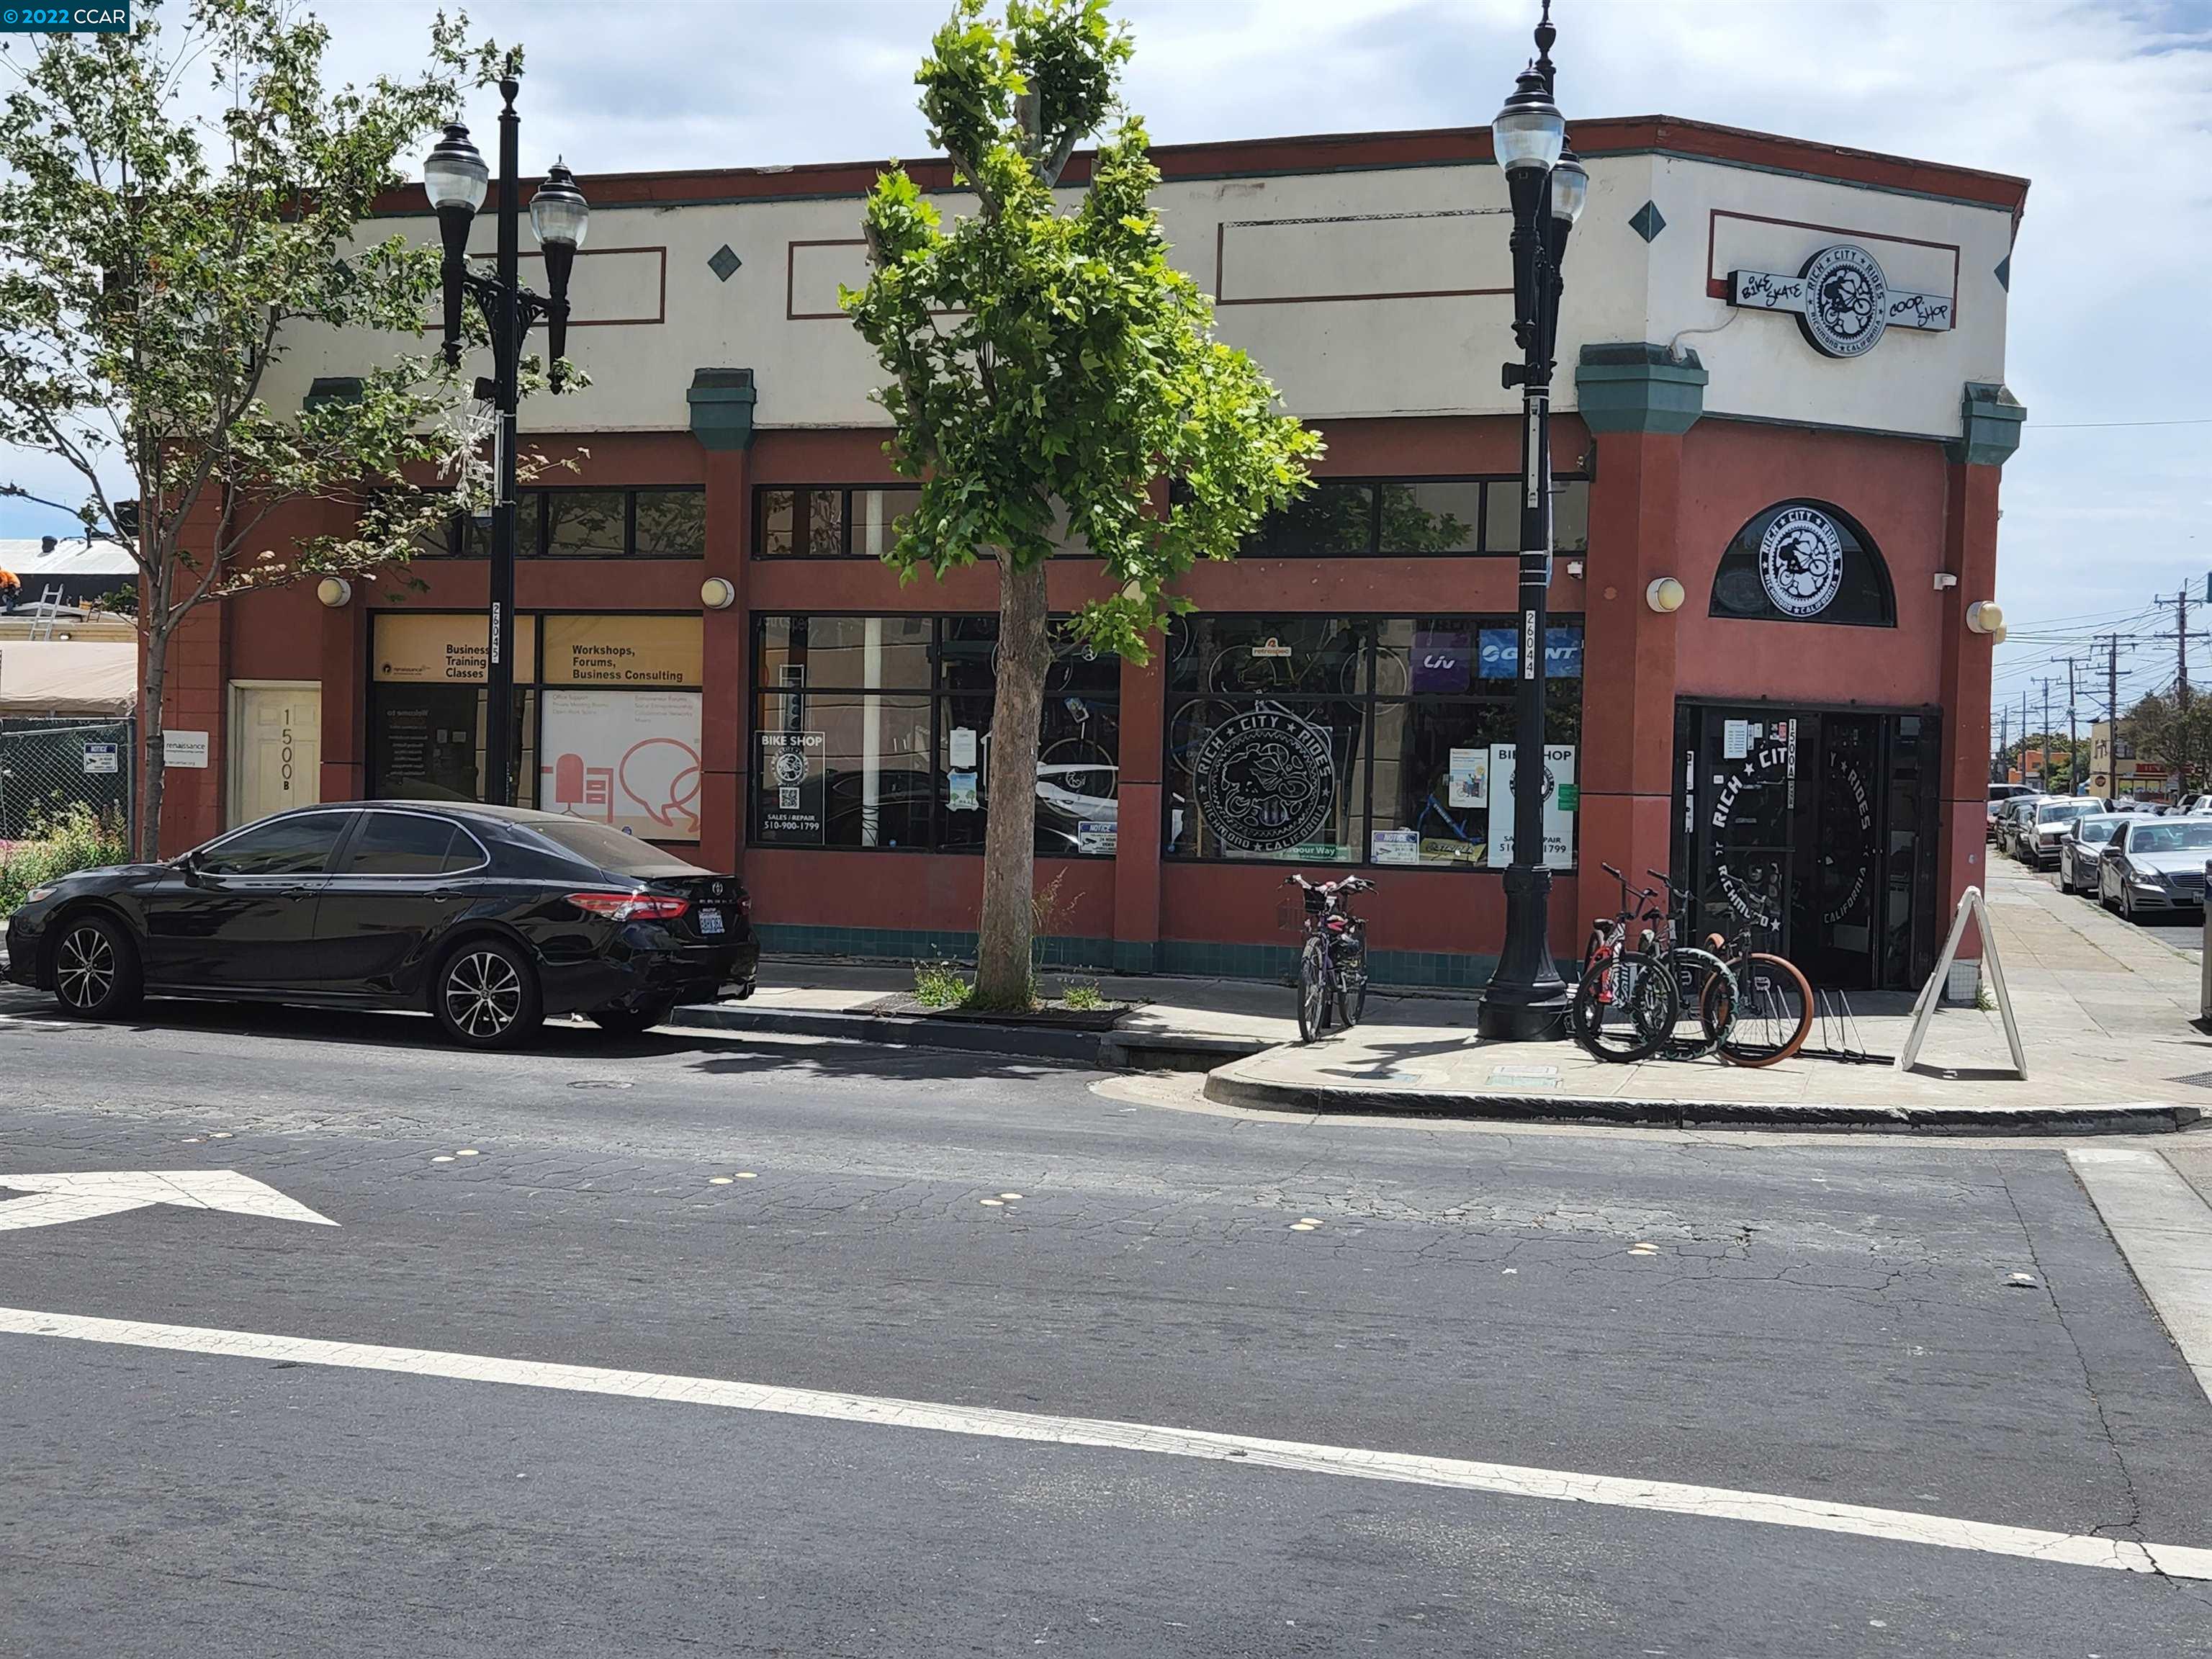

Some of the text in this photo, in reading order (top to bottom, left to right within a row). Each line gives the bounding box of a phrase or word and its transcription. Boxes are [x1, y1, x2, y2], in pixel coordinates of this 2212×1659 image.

[1808, 250, 1884, 300] RICH CITY RIDES
[1742, 274, 1773, 299] BIKE
[1766, 284, 1802, 307] SKATE
[1918, 305, 1948, 327] SHOP
[1811, 312, 1881, 351] RICHMOND CALIFORNIA
[1762, 511, 1840, 560] RICH CITY RIDES
[1800, 580, 1837, 613] CALIFORNIA
[446, 644, 489, 654] Business
[572, 645, 635, 657] Workshops,
[1501, 648, 1578, 660] GNT
[446, 656, 487, 669] Training
[573, 657, 616, 668] Forums,
[1424, 655, 1455, 669] Liv
[446, 667, 483, 678] Classes
[573, 670, 683, 683] Business Consulting
[762, 735, 822, 746] BIKE SHOP
[1197, 716, 1331, 777] RICH CITY RIDES
[1544, 750, 1571, 760] HOP
[1712, 775, 1743, 828] RICH
[1848, 768, 1871, 830] RIDES
[764, 821, 819, 830] 510-900-1799
[1202, 801, 1326, 851] RICHMOND CALIFORNIA
[1316, 847, 1335, 856] Way
